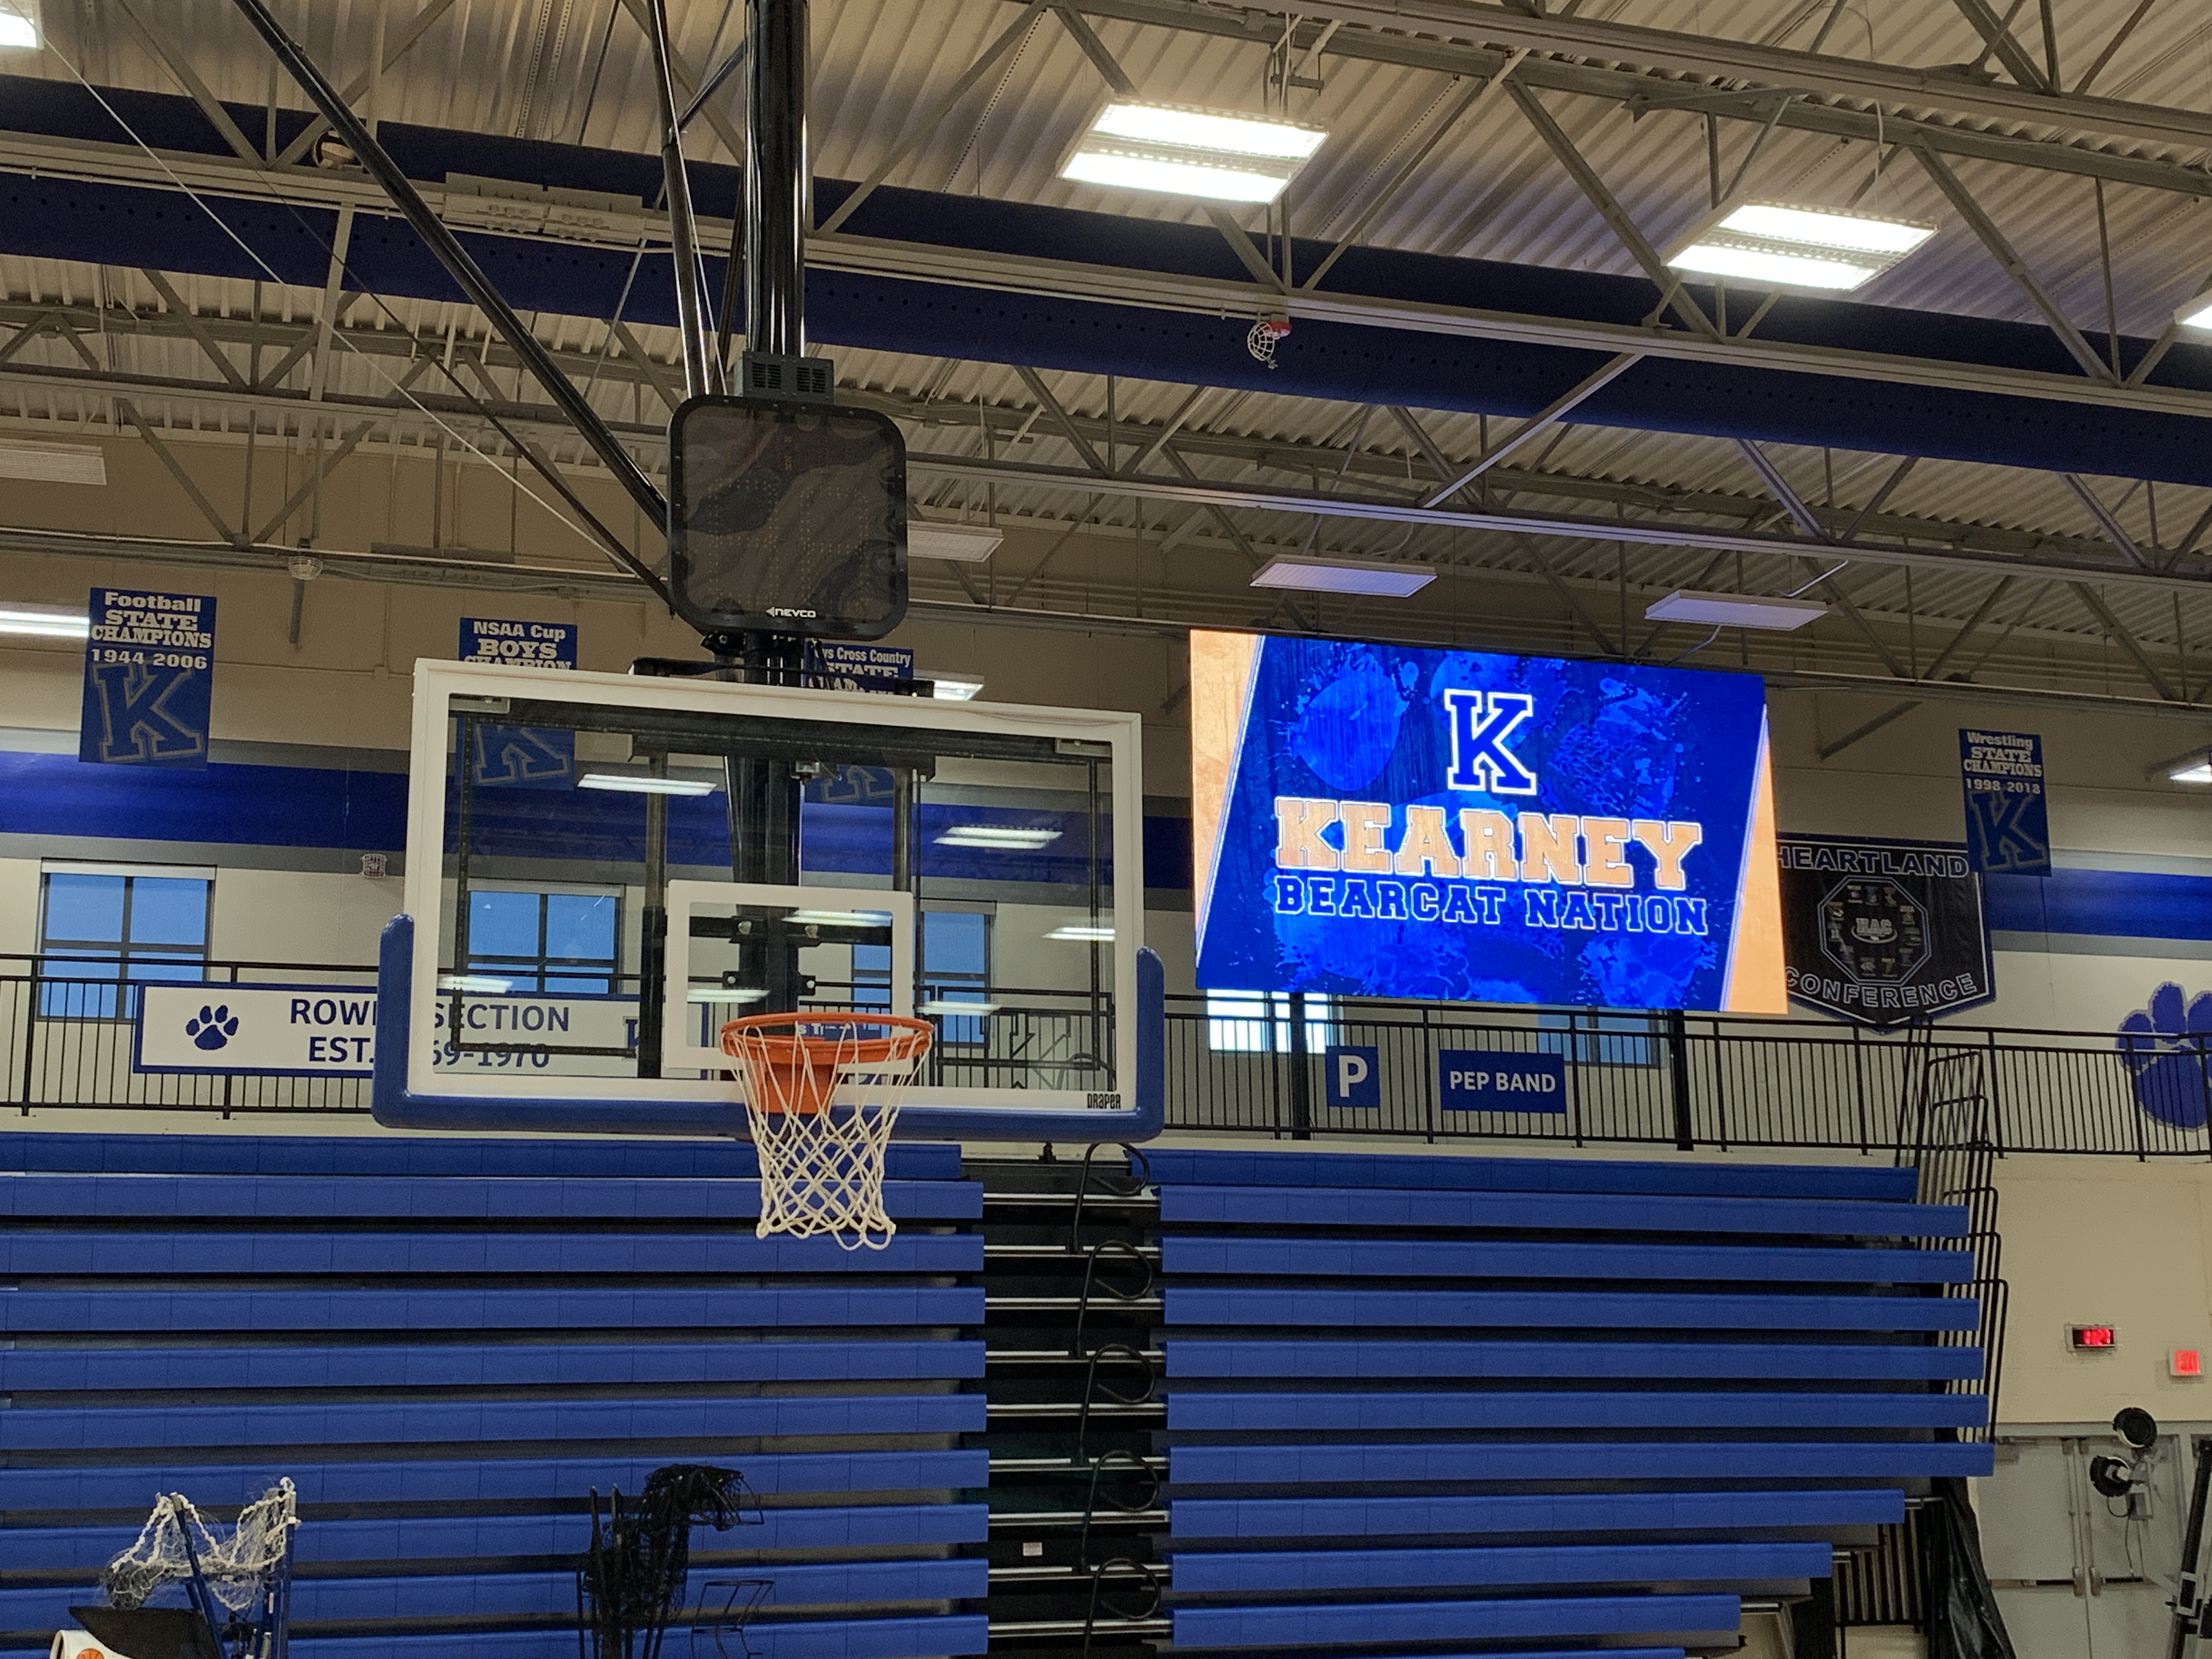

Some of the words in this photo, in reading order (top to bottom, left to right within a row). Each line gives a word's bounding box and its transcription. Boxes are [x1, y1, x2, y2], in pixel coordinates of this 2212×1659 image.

[104, 591, 201, 612] Football
[105, 609, 198, 631] STATE
[775, 608, 817, 618] NEVCO
[91, 624, 212, 648] CHAMPIONS
[473, 621, 525, 636] NSAA
[530, 624, 566, 642] Cup
[92, 648, 144, 665] 1944
[153, 654, 207, 670] 2006
[477, 638, 557, 659] BOYS
[837, 647, 867, 662] Cross
[870, 649, 912, 668] Country
[1444, 689, 1537, 795] K
[1966, 731, 2033, 751] Wrestling
[1971, 746, 2032, 763] STATE
[1963, 758, 2042, 777] CHAMPIONS
[1966, 778, 2001, 791] 1998
[2007, 782, 2041, 794] 2018
[1274, 796, 1702, 890] KEARNEY
[1274, 875, 1506, 924] BEARCAT
[1525, 890, 1708, 936] NATION
[1786, 966, 1978, 1008] CONFERENCE
[290, 998, 378, 1026] ROW
[1338, 1054, 1368, 1098] P
[1449, 1070, 1490, 1091] PEP
[1495, 1072, 1556, 1093] BAND
[1087, 1093, 1121, 1109] DRAPER
